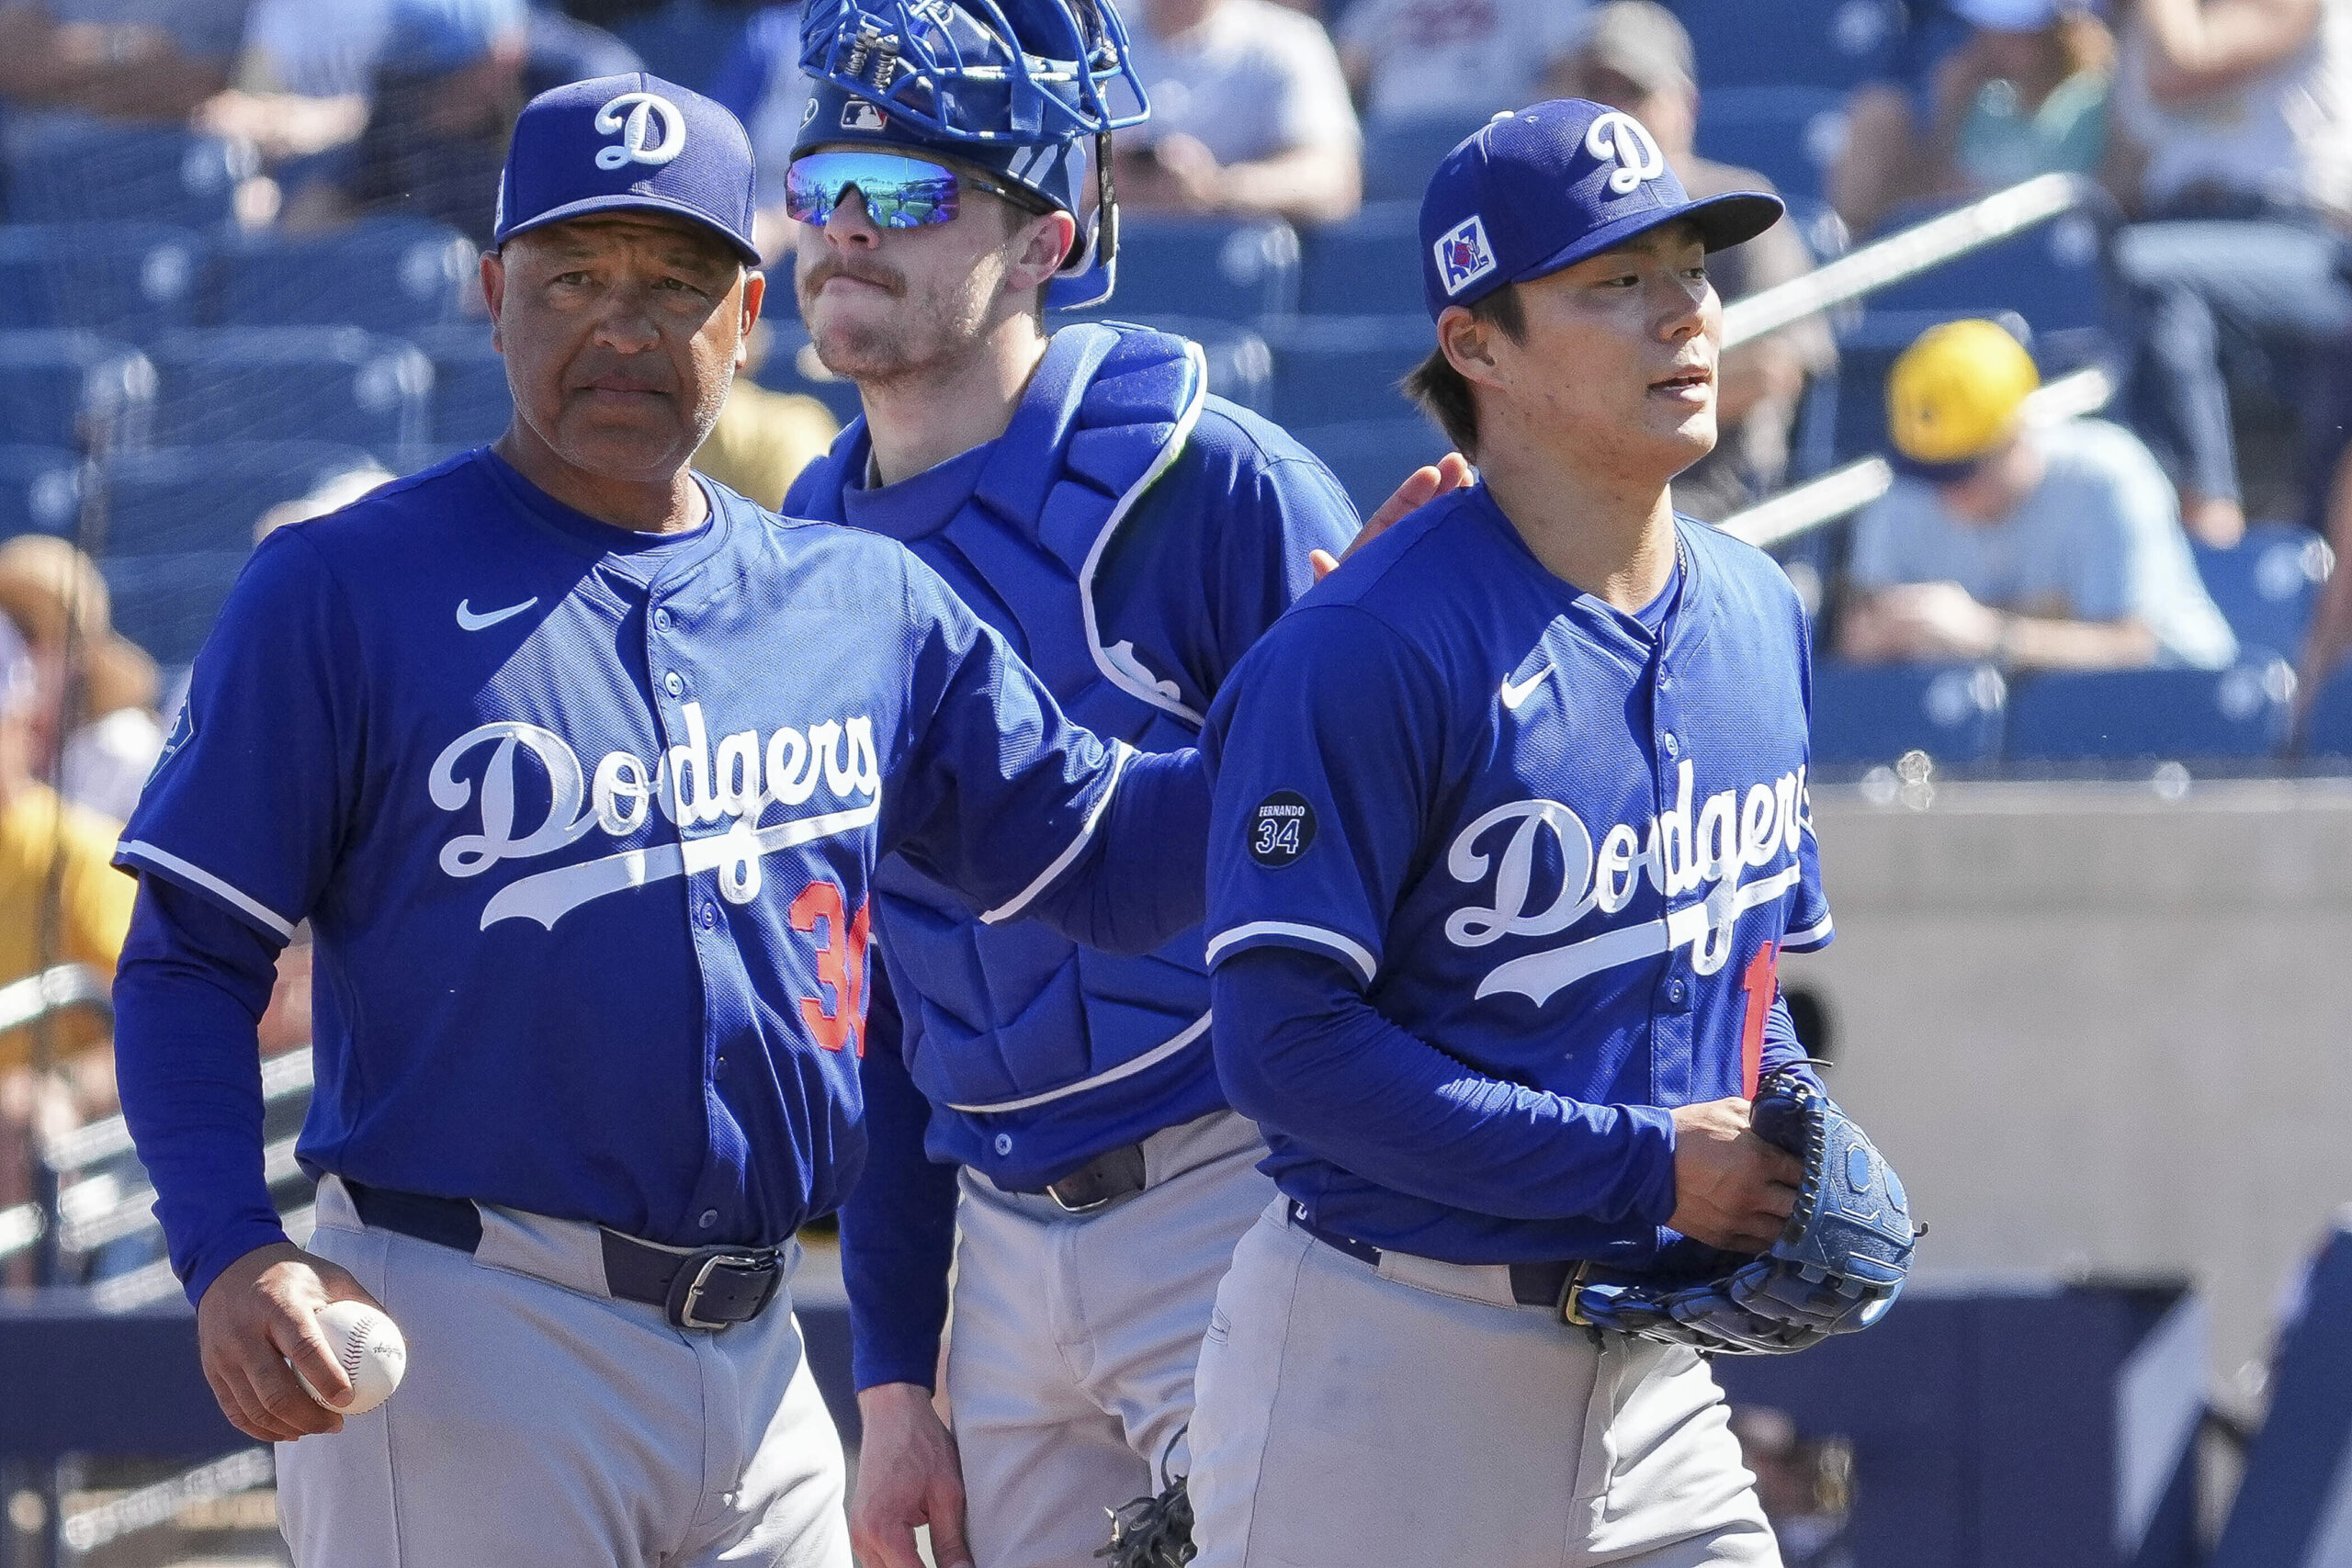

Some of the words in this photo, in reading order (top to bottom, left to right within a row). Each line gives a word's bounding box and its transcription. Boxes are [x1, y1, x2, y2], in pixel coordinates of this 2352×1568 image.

[594, 93, 686, 170] D
[1585, 112, 1664, 195] D
[428, 701, 881, 906] Dodgers
[1256, 818, 1300, 854] 34
[1259, 805, 1306, 818] FERNANDO
